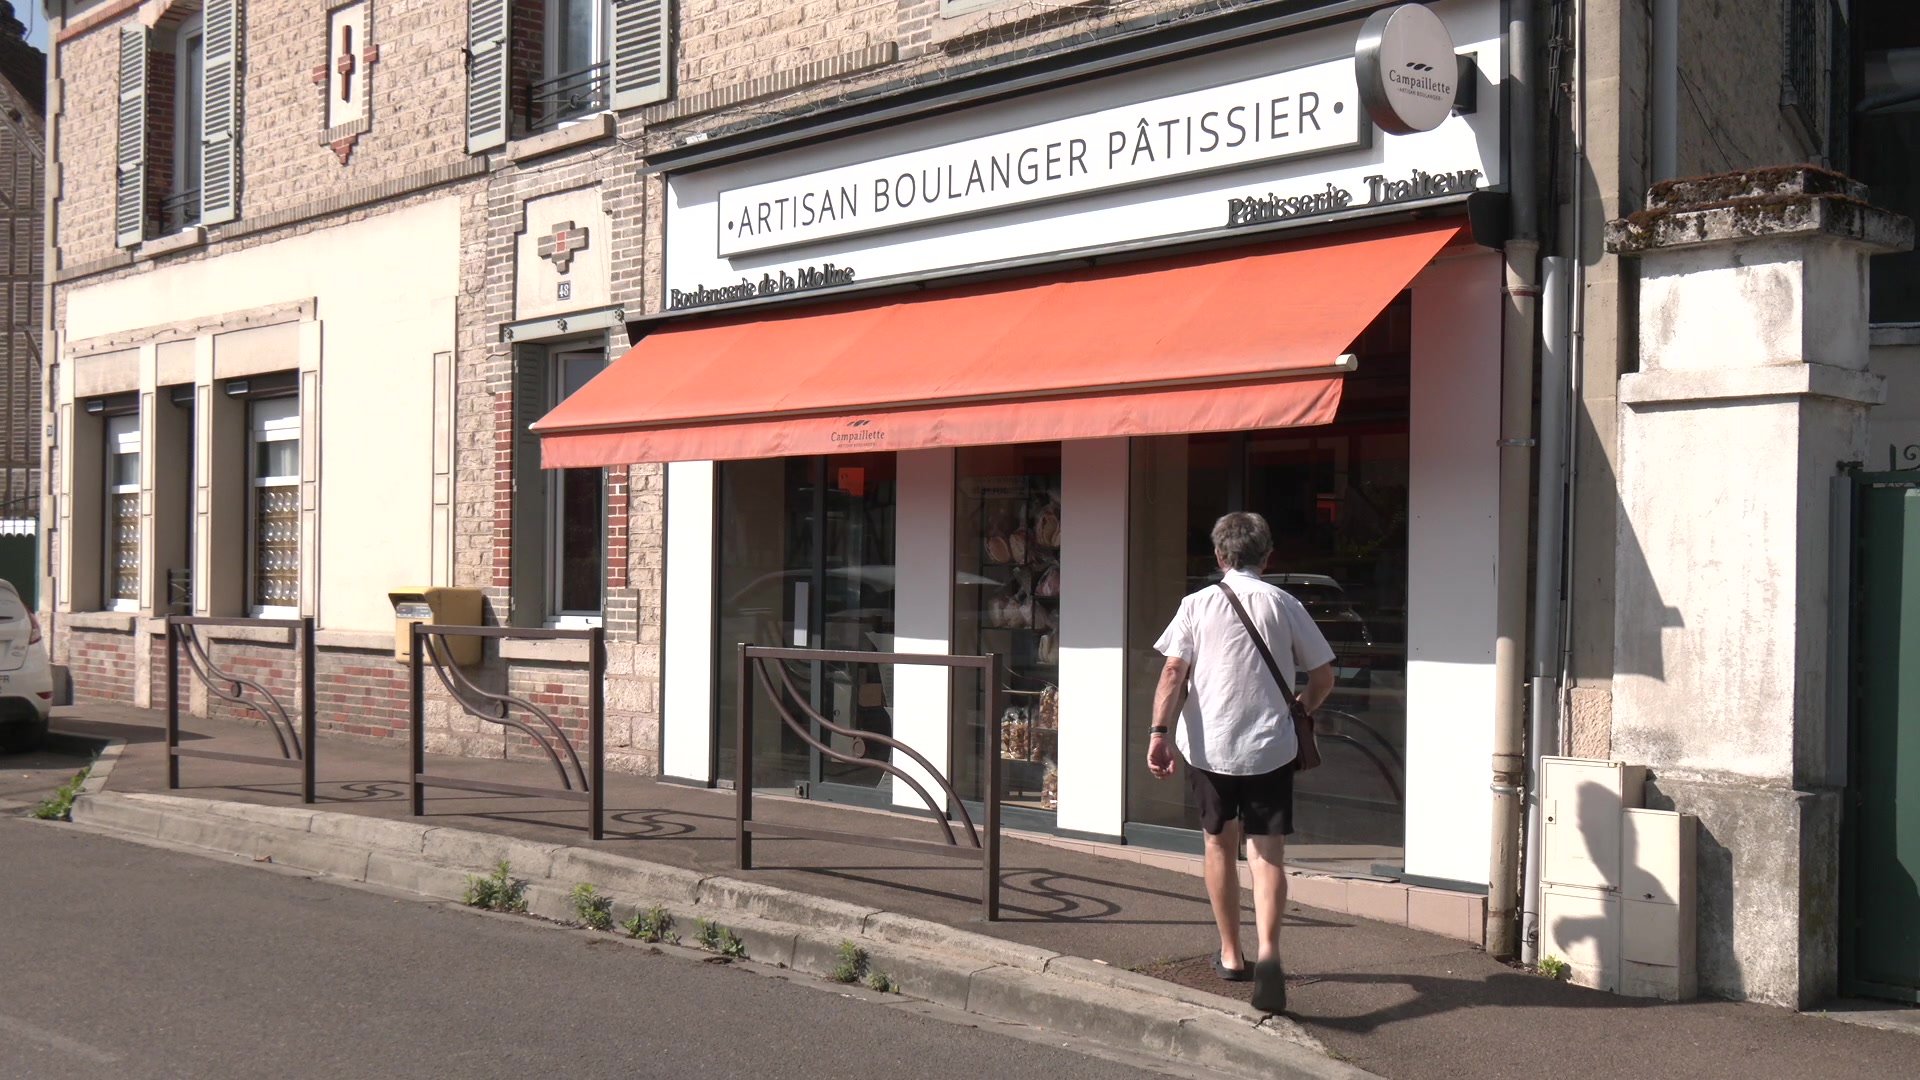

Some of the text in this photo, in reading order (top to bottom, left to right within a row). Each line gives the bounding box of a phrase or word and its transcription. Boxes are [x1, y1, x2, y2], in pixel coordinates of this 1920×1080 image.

[1389, 70, 1450, 94] Campaillette
[738, 91, 1321, 238] ARTISAN BOULANGER PÂTISSIER
[1226, 168, 1480, 228] Pâtisserie Traiteur
[559, 284, 569, 297] 48
[670, 263, 855, 310] Boulangerie de la Moline
[830, 430, 885, 443] Campaillette
